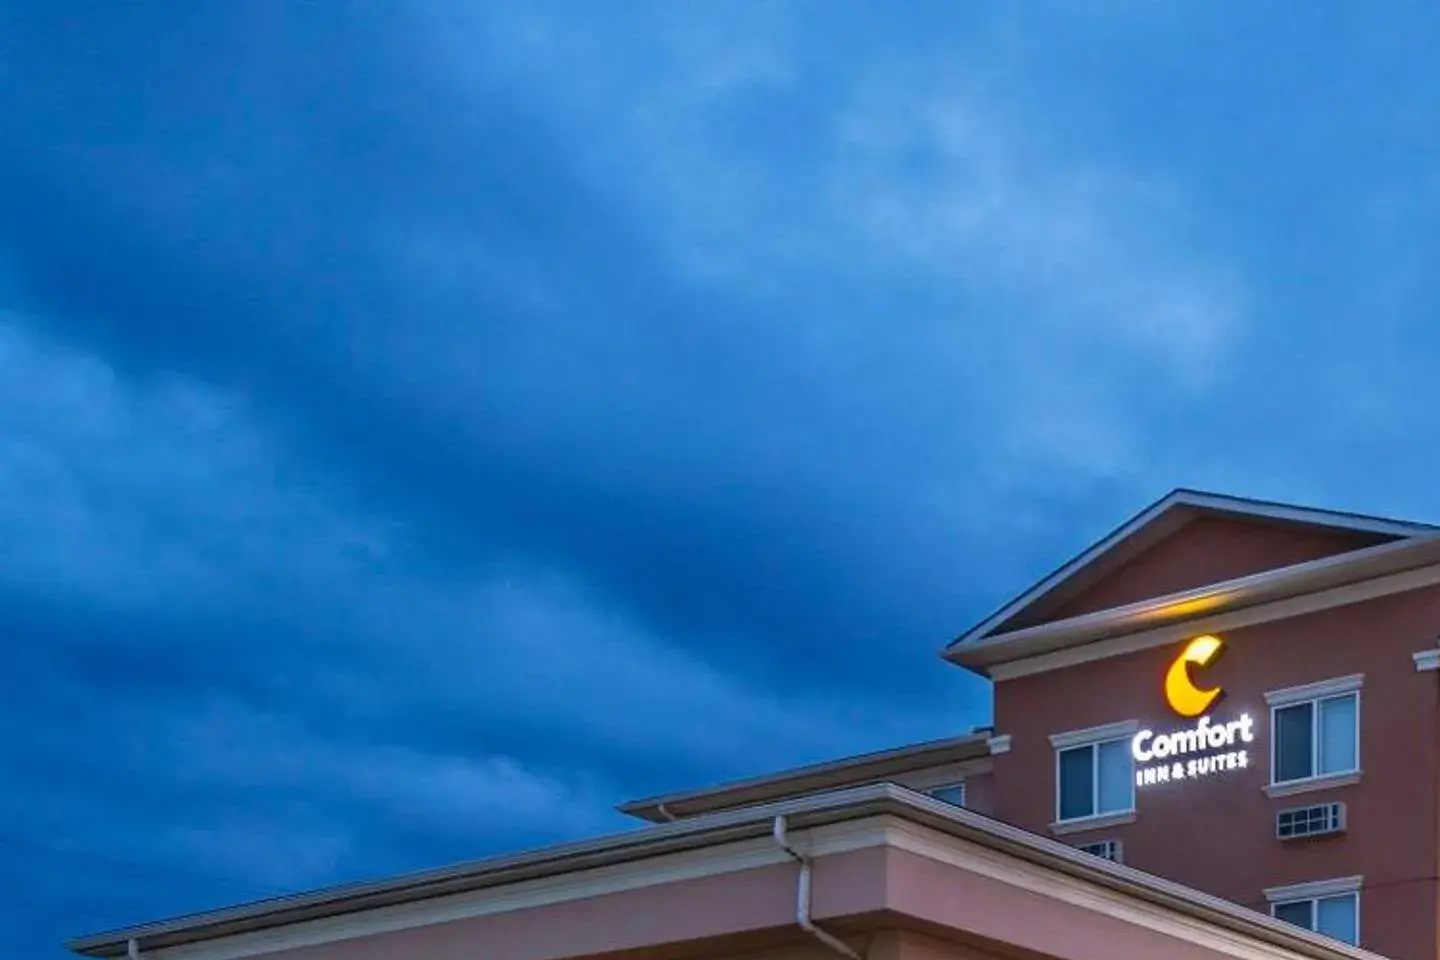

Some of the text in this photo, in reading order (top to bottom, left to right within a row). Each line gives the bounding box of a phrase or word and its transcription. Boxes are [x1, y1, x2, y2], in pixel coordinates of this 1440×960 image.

[1132, 713, 1254, 761] Comfort
[1136, 750, 1249, 786] INN & SUITES
